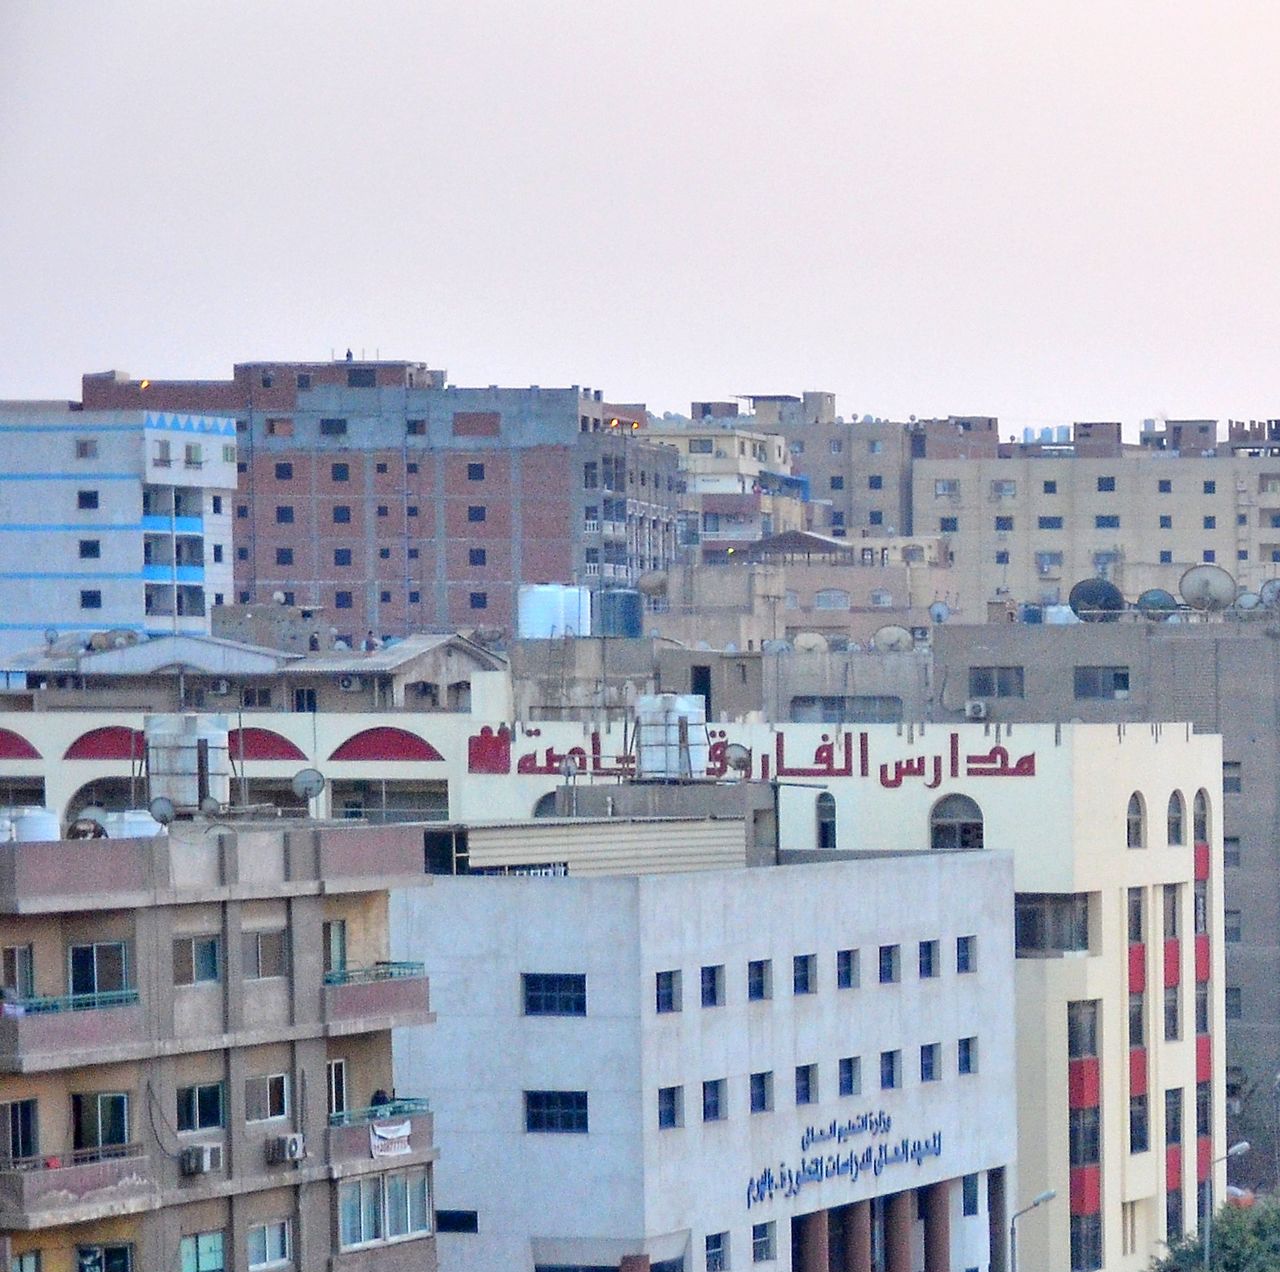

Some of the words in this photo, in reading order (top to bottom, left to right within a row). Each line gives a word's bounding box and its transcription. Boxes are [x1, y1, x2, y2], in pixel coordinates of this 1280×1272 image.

[880, 733, 1036, 790] مدارس
[838, 1112, 869, 1144] التعليم
[869, 1110, 893, 1135] وزارة
[910, 1131, 942, 1167] المعهد
